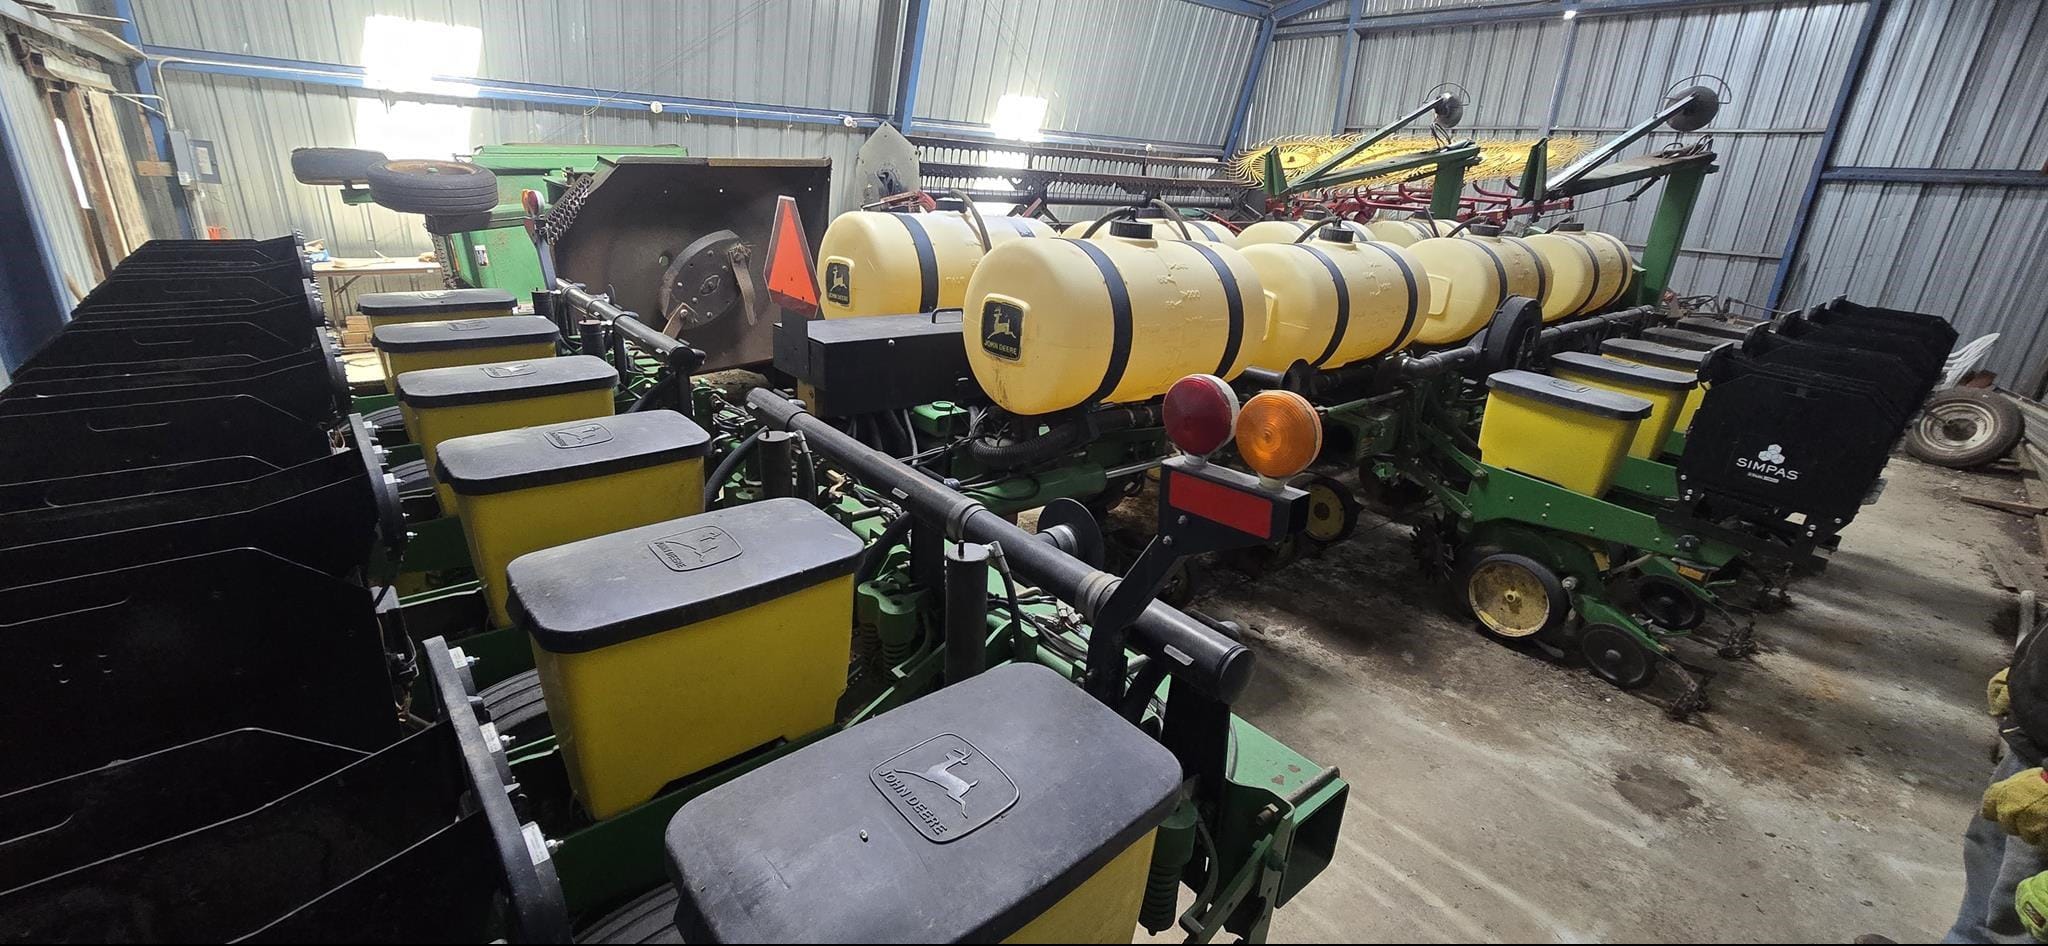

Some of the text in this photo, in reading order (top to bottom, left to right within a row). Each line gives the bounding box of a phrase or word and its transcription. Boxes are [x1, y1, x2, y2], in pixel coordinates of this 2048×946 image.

[984, 340, 1017, 355] JOHN DEERE
[1736, 457, 1799, 481] SIMPAS
[878, 770, 948, 836] JOHN DEERE
